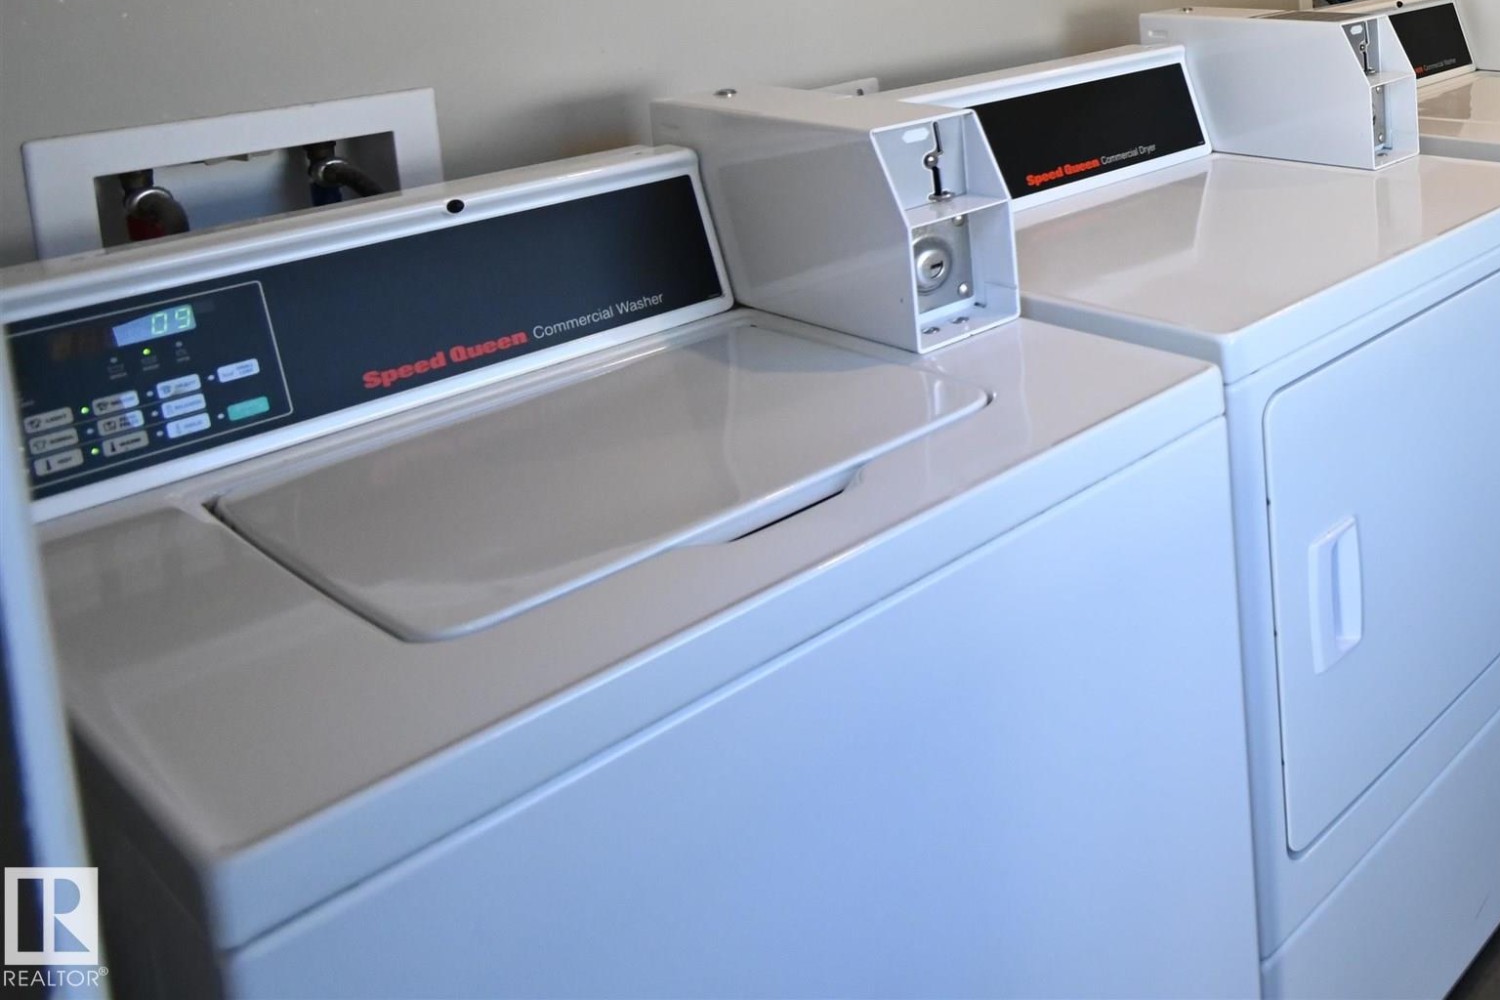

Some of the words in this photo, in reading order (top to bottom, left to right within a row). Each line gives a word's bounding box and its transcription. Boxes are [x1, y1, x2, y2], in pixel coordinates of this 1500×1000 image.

[1025, 166, 1064, 187] Speed
[1064, 157, 1100, 175] Queen
[1100, 147, 1138, 165] Commercial
[1139, 143, 1156, 155] Dryer
[151, 307, 191, 335] 09
[362, 351, 447, 389] Speed
[449, 330, 528, 364] Queen
[532, 305, 614, 340] Commercial
[615, 292, 664, 316] Washer
